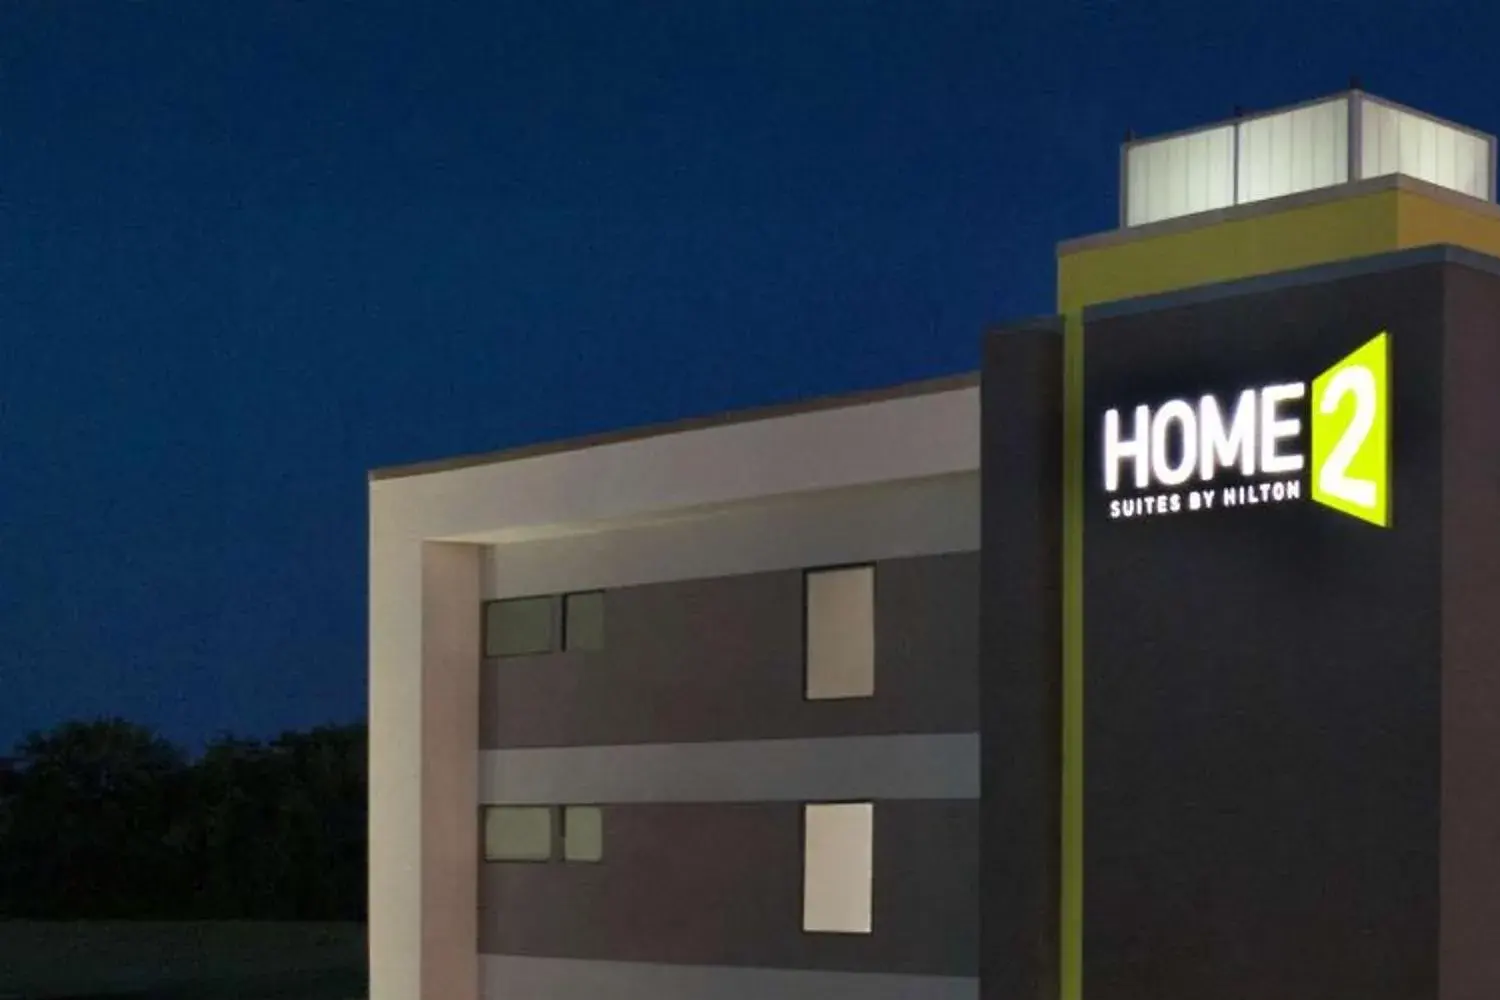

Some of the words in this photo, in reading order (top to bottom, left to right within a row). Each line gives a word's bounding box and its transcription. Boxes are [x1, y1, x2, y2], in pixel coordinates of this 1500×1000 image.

[1104, 382, 1304, 491] HOME
[1110, 493, 1181, 518] SUITES
[1189, 491, 1216, 510] BY
[1223, 480, 1300, 506] HILTON
